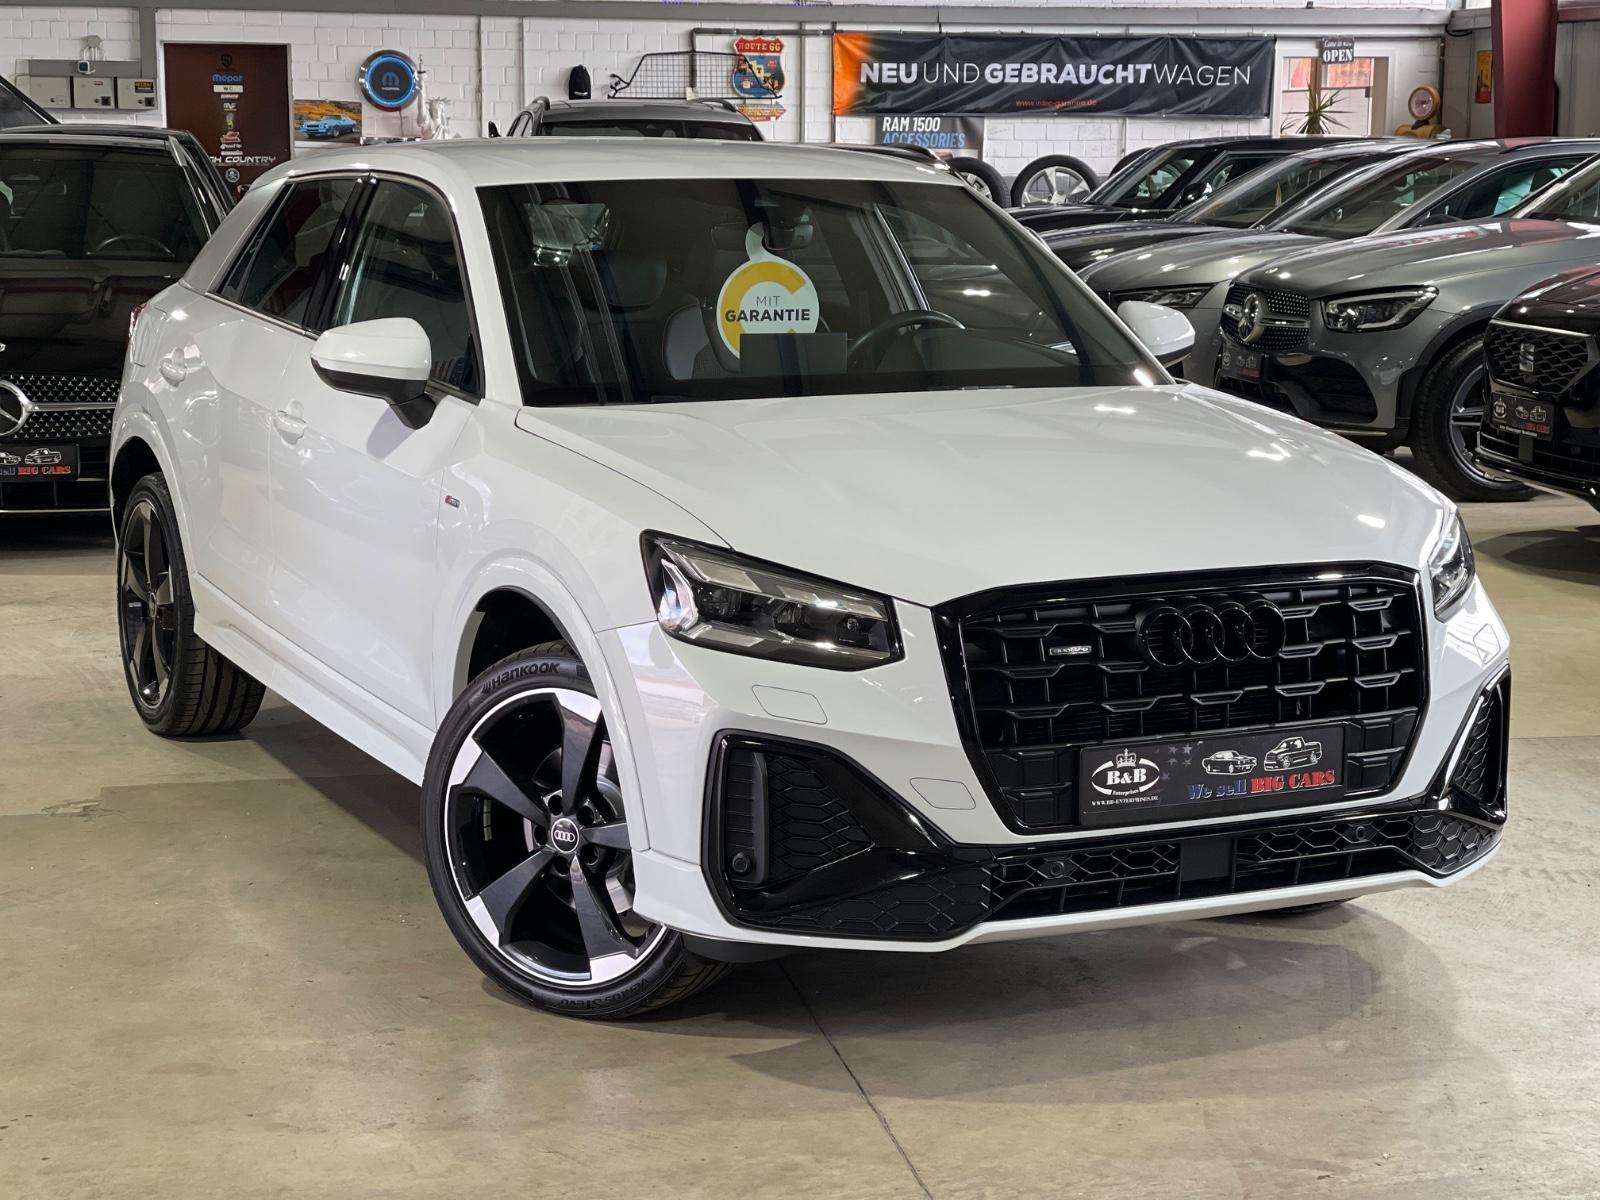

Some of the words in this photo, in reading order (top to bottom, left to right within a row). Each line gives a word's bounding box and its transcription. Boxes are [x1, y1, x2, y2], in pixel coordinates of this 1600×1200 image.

[769, 43, 781, 51] 66
[1323, 49, 1352, 62] OPEN
[860, 63, 917, 83] NEU
[924, 63, 980, 84] UND
[883, 117, 909, 131] RAM
[913, 117, 940, 131] 1500
[883, 132, 966, 147] ACCESSORIES
[756, 296, 780, 306] MIT
[725, 309, 810, 322] GARANTIE
[1106, 768, 1147, 785] B&B
[1187, 784, 1212, 800] We
[1216, 778, 1247, 797] sell
[1250, 775, 1284, 794] BIG
[1288, 769, 1336, 789] CARS
[1112, 788, 1139, 796] Enterprises
